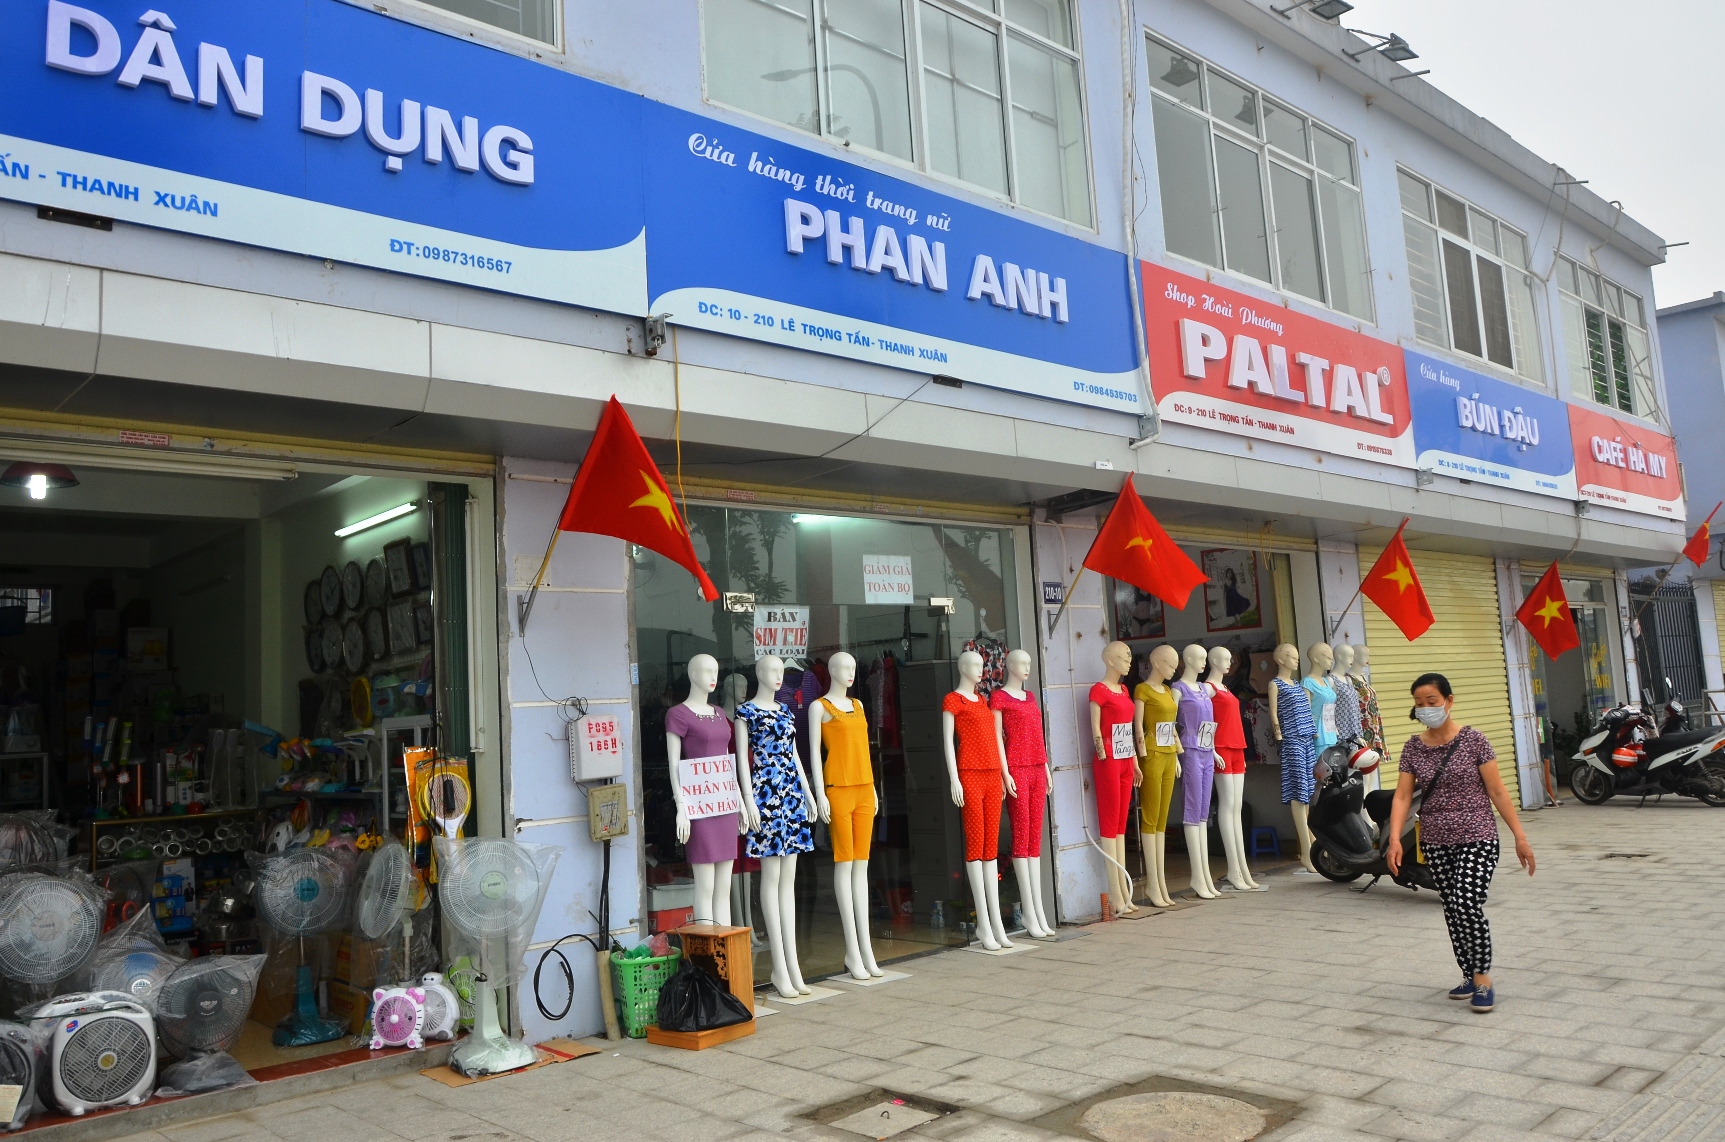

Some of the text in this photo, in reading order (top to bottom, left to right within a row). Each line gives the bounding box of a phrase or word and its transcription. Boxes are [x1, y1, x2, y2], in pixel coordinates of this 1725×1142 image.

[45, 0, 535, 185] DÂN DỤNG
[57, 171, 139, 201] THANH
[154, 190, 218, 217] XUÂN
[688, 133, 951, 232] Cửa hàng thời trang nữ
[783, 197, 1069, 323] PHAN ANH
[1164, 282, 1284, 336] Shop Hoài Phương
[698, 301, 723, 318] ĐC:
[753, 313, 774, 327] 210
[780, 318, 796, 332] LÊ
[801, 322, 842, 342] TRỌNG
[878, 338, 915, 356] THANH
[918, 348, 948, 364] XUÂN
[1420, 362, 1460, 391] Cửa hàng
[1208, 409, 1216, 419] LÊ
[1218, 412, 1239, 424] TRỌNG
[1456, 393, 1540, 451] BÚN ĐẬU
[1590, 435, 1667, 479] CAFÉ HÀ MY
[864, 562, 911, 575] GIẢM GIÁ
[867, 580, 911, 595] TOÀN BỘ
[766, 608, 798, 623] BÁN
[755, 627, 778, 646] SIM
[756, 648, 806, 657] CÁC LOẠI
[682, 777, 737, 796] NHÂN VIÊ
[688, 800, 714, 816] BÁN
